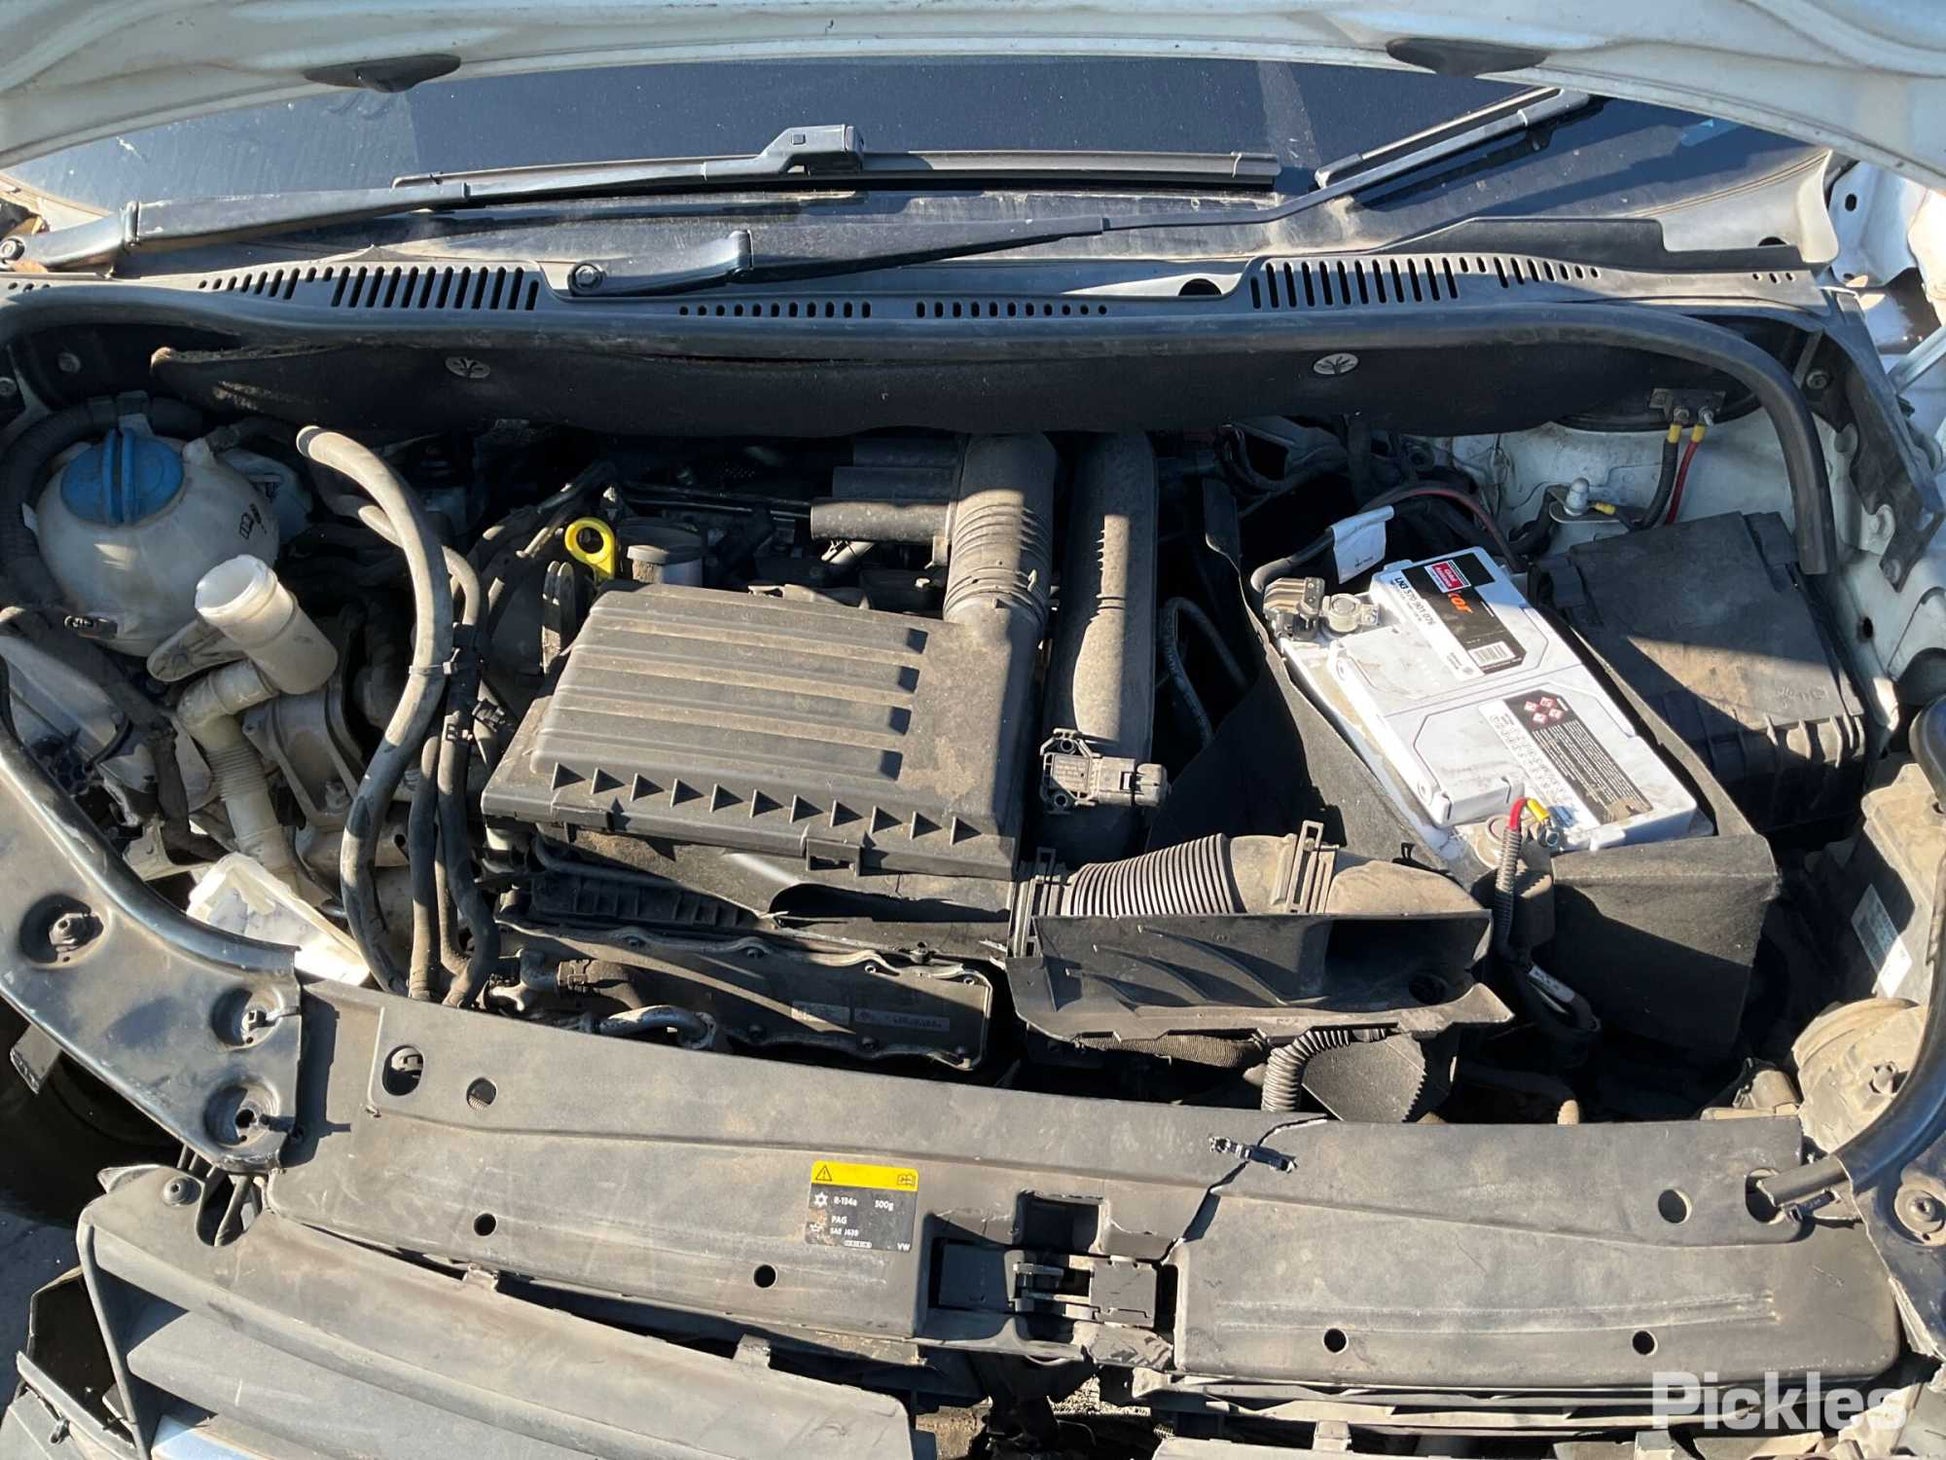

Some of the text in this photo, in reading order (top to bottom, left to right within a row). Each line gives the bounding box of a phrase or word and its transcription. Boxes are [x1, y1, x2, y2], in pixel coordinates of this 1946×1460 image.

[1394, 577, 1409, 589] LN3
[874, 1199, 894, 1211] 500g
[831, 1215, 848, 1225] PAG
[896, 1242, 911, 1251] VW
